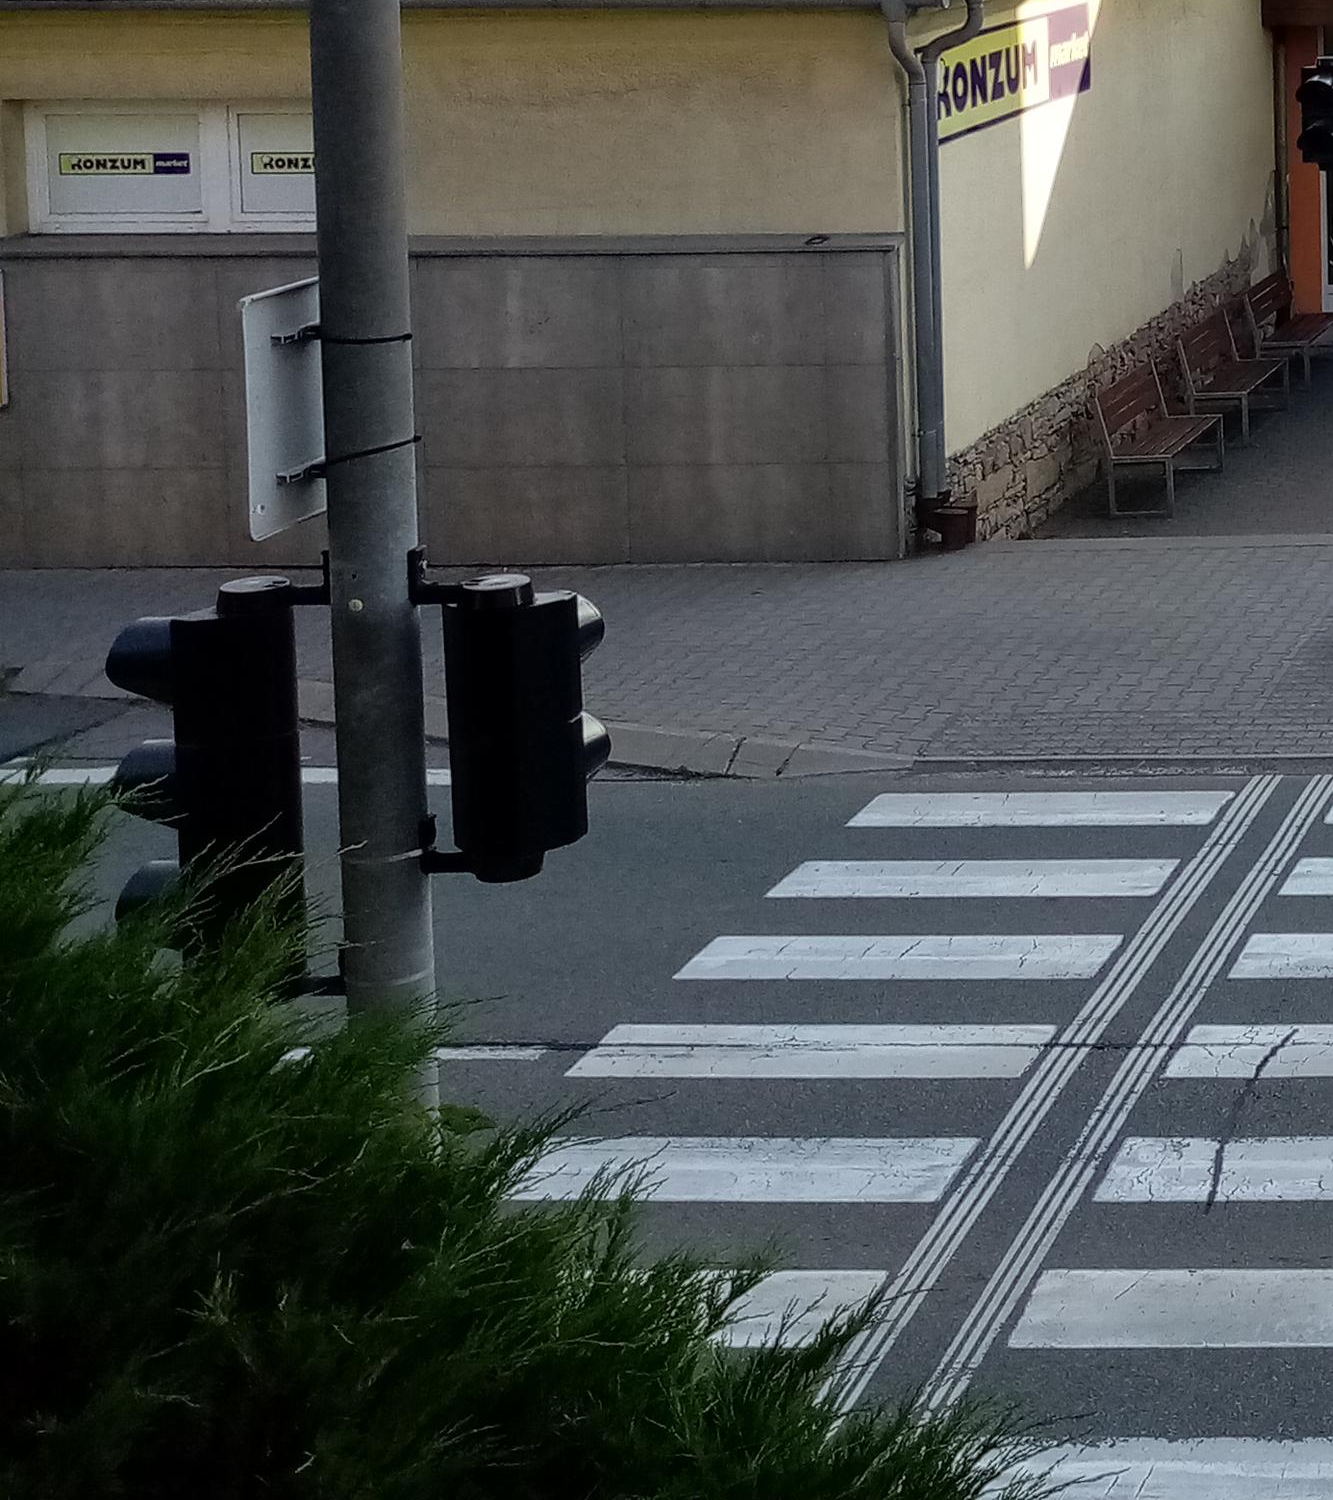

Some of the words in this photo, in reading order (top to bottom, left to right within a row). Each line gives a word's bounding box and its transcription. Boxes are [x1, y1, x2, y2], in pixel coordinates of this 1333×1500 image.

[937, 39, 1039, 120] KONZUM
[70, 157, 146, 171] KONZUM
[261, 156, 315, 170] KONZ
